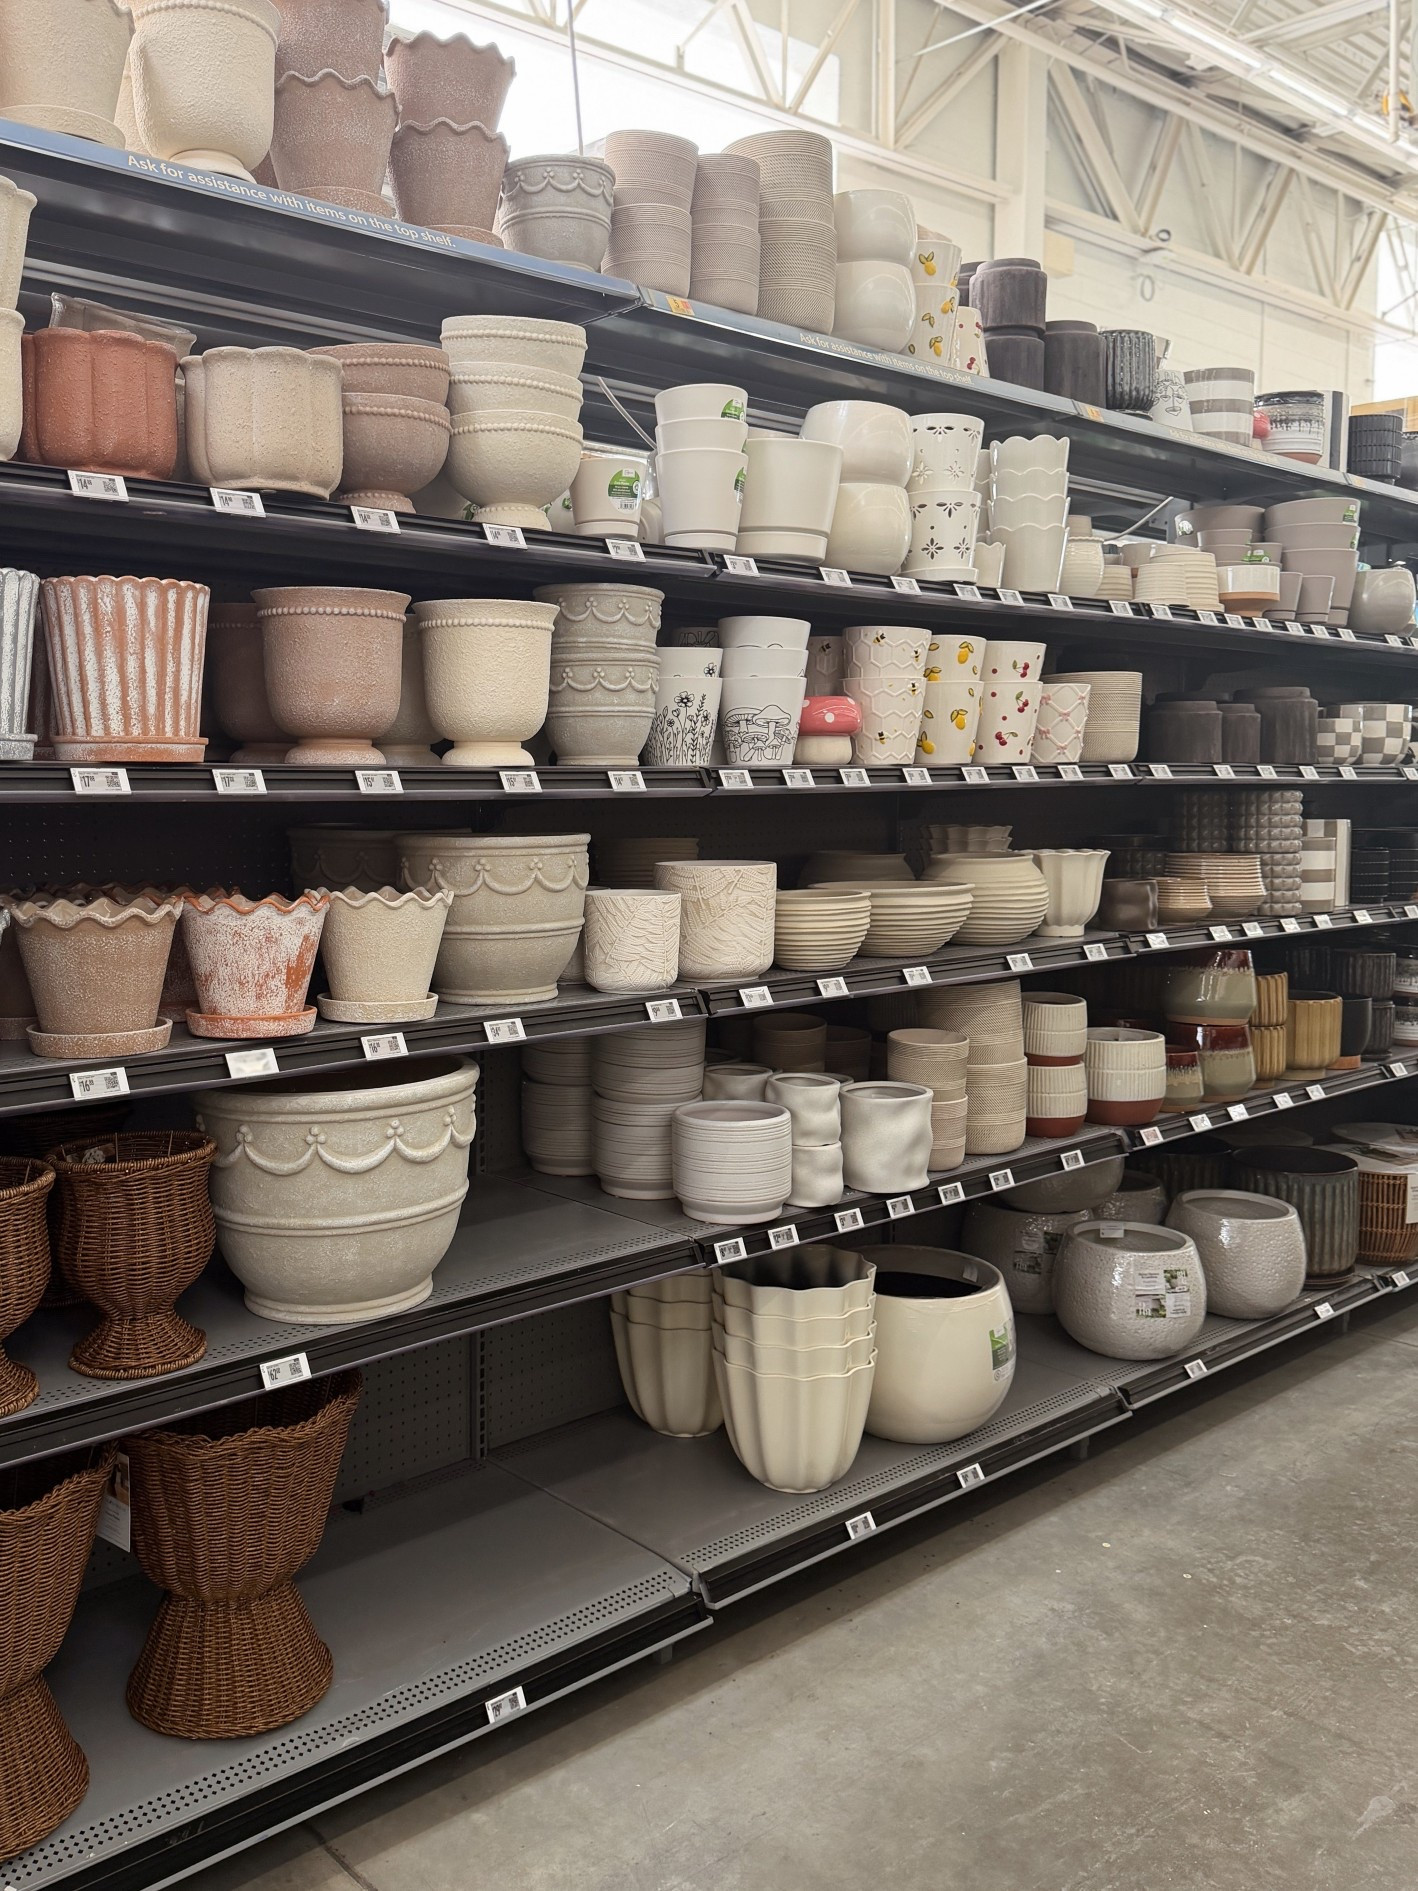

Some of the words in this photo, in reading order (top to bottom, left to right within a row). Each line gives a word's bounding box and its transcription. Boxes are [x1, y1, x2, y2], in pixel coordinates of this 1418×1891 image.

[128, 155, 158, 172] Ask
[160, 163, 184, 178] for
[188, 173, 267, 200] assistance
[270, 193, 303, 210] with
[305, 201, 346, 220] items
[349, 214, 367, 226] on
[369, 217, 393, 232] the
[394, 224, 418, 240] top
[421, 231, 456, 247] shelf.
[799, 333, 815, 345] Ask
[816, 337, 829, 348] for
[831, 342, 873, 360] assistance
[873, 352, 891, 364] with
[892, 356, 914, 370] items
[916, 364, 926, 374] on
[926, 366, 939, 377] the
[940, 370, 953, 383] top
[954, 374, 974, 385] shelf.
